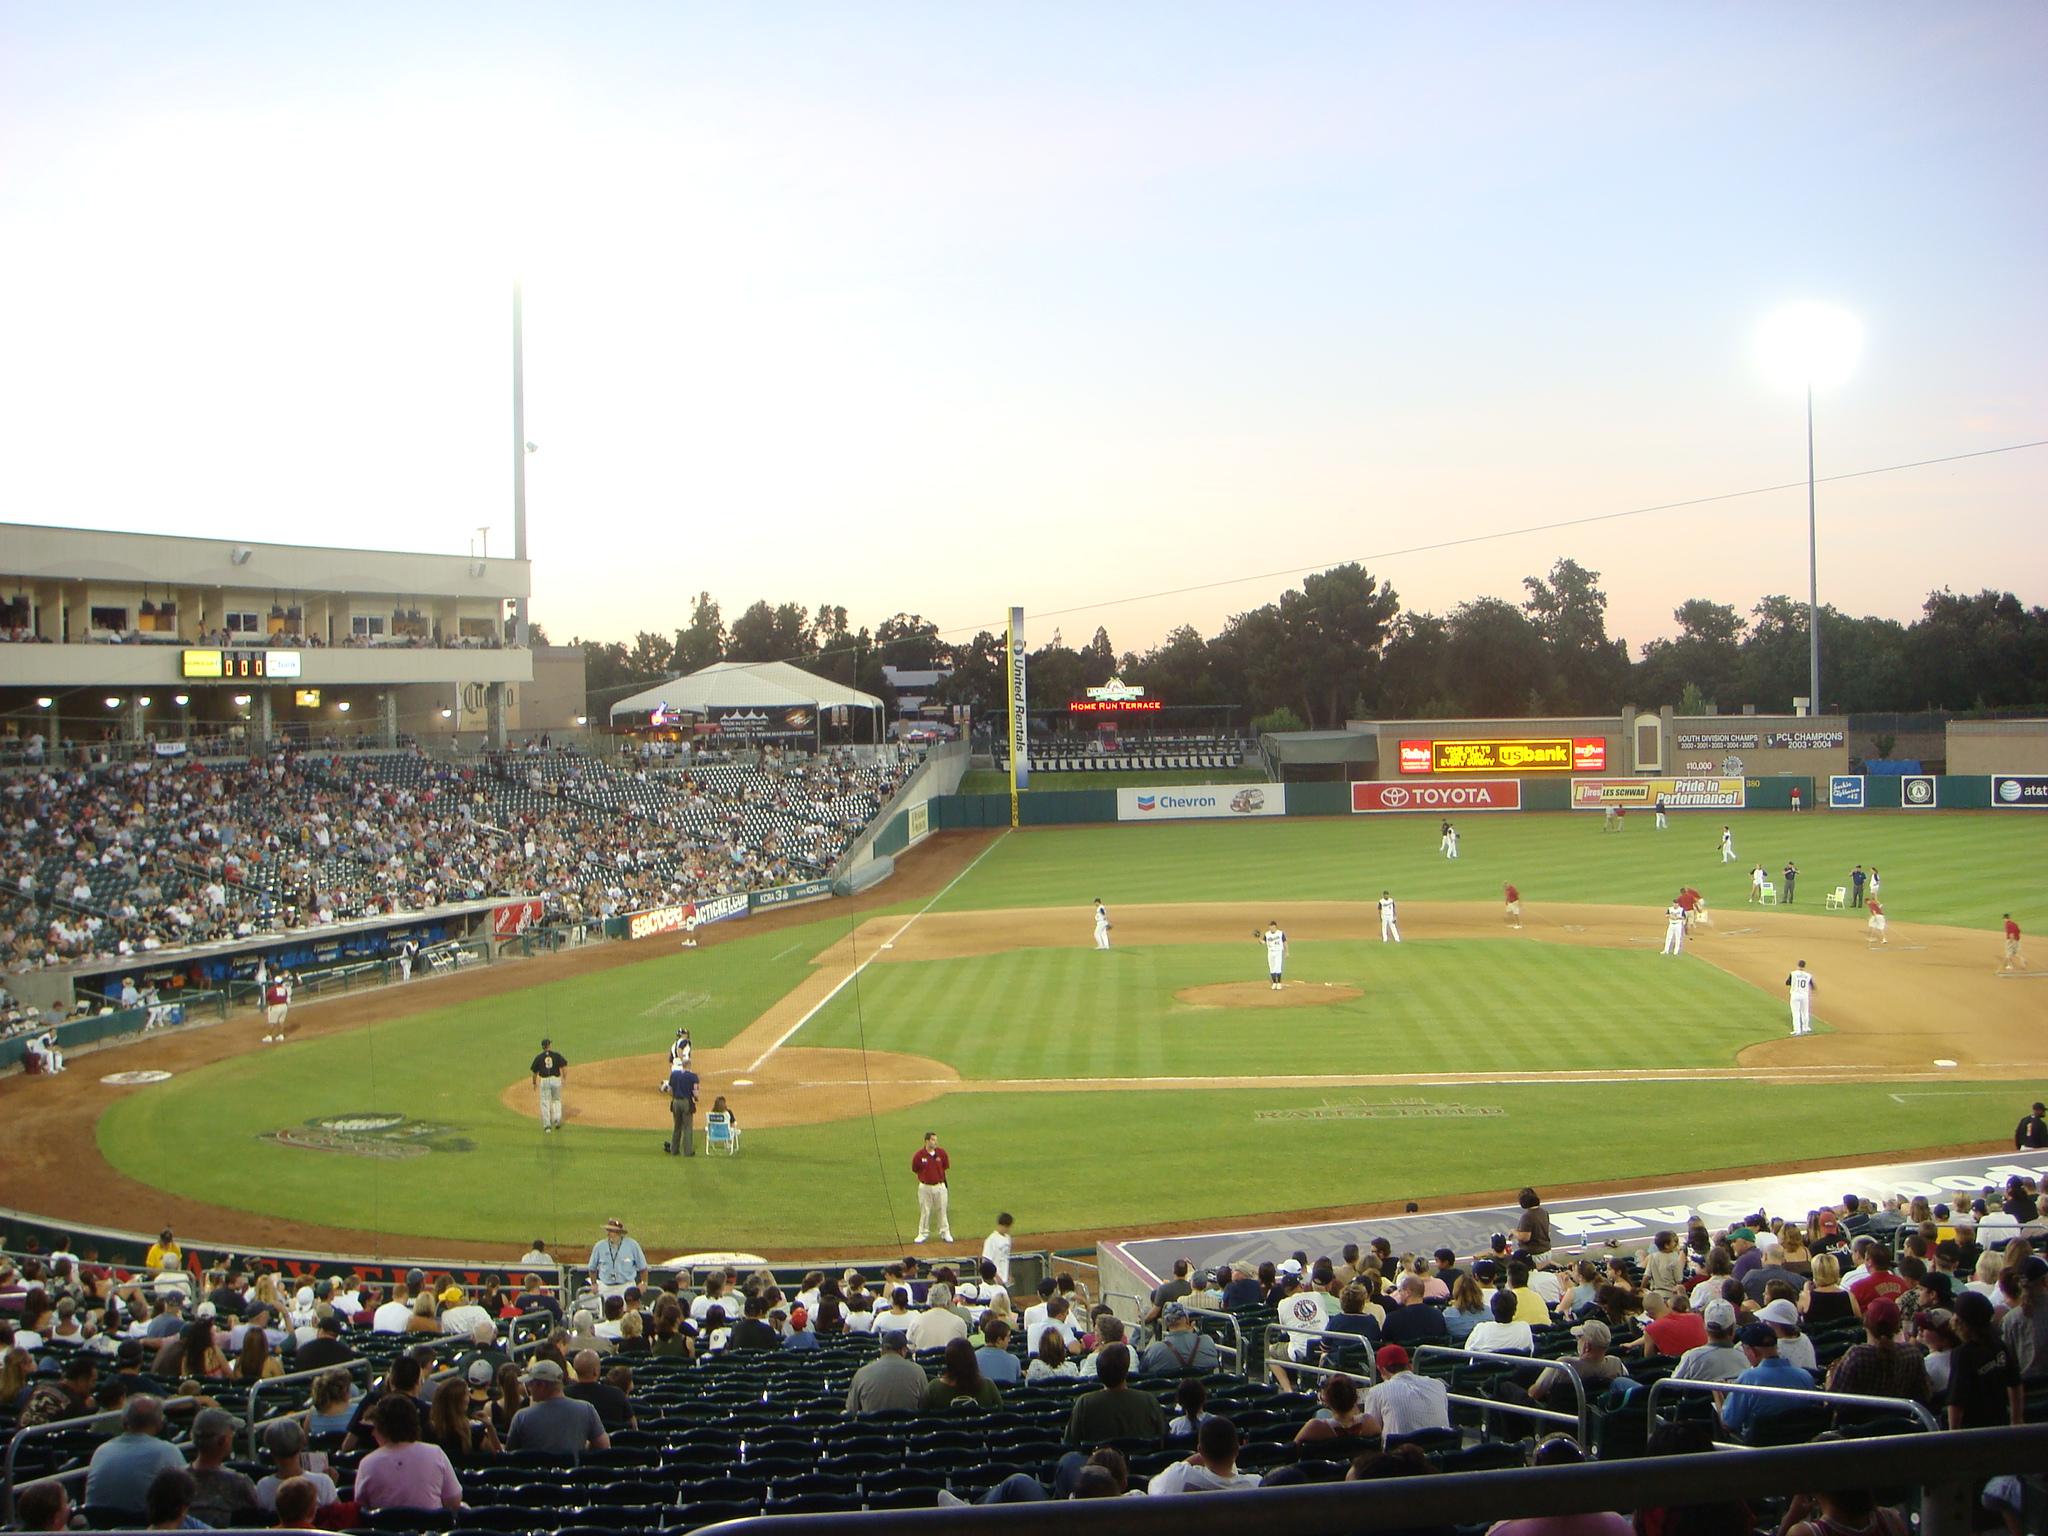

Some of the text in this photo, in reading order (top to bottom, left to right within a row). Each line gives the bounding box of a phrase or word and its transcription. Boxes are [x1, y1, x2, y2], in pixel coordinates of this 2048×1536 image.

[1014, 659, 1025, 752] United Rentals
[1098, 702, 1117, 710] RUN
[1119, 701, 1160, 710] TERRACE
[1700, 734, 1729, 742] DIVISION
[1730, 734, 1759, 742] CHAMPS
[1776, 732, 1843, 741] PCL CHAMPIONS
[1788, 740, 1832, 749] 2003 2004
[1686, 761, 1713, 771] $10,000
[1674, 779, 1720, 793] Pride In
[2024, 785, 2048, 796] at&t
[1412, 788, 1491, 804] TOYOTA
[1602, 788, 1615, 797] LES
[1615, 788, 1646, 797] SCHWAB
[1160, 796, 1216, 808] Chevron
[1656, 791, 1739, 806] Performance!
[775, 889, 782, 901] 3
[695, 894, 748, 925] ACTICKET.COM
[1797, 979, 1807, 989] 10
